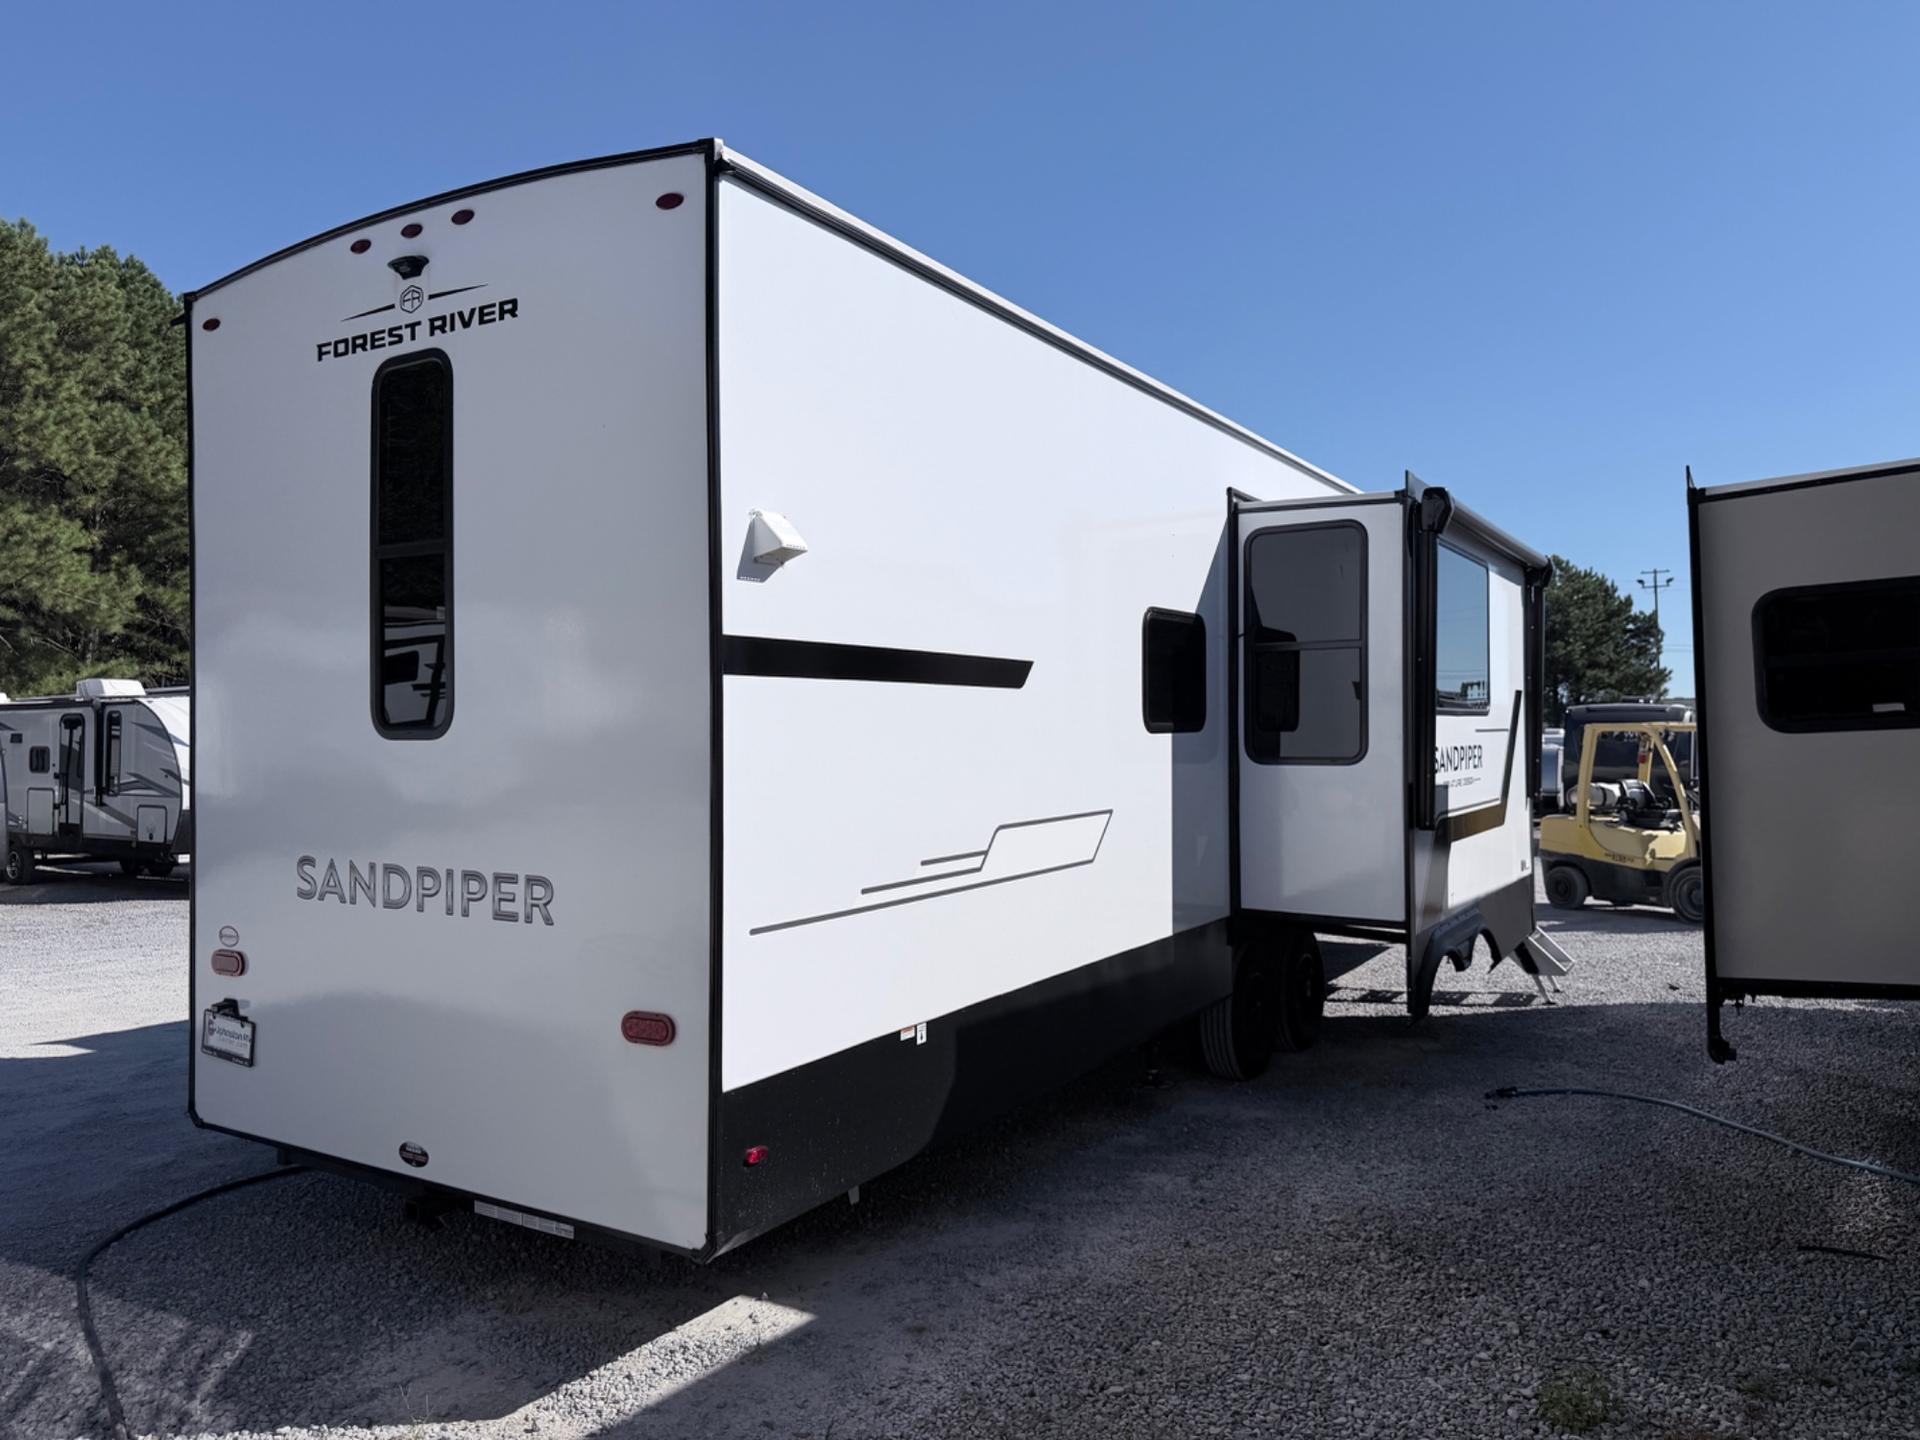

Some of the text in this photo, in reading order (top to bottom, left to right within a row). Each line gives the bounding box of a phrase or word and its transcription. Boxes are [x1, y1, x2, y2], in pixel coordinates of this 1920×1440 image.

[316, 298, 518, 362] FOREST RIVER
[1434, 744, 1483, 774] SANDPIPER
[296, 855, 554, 926] SANDPIPER
